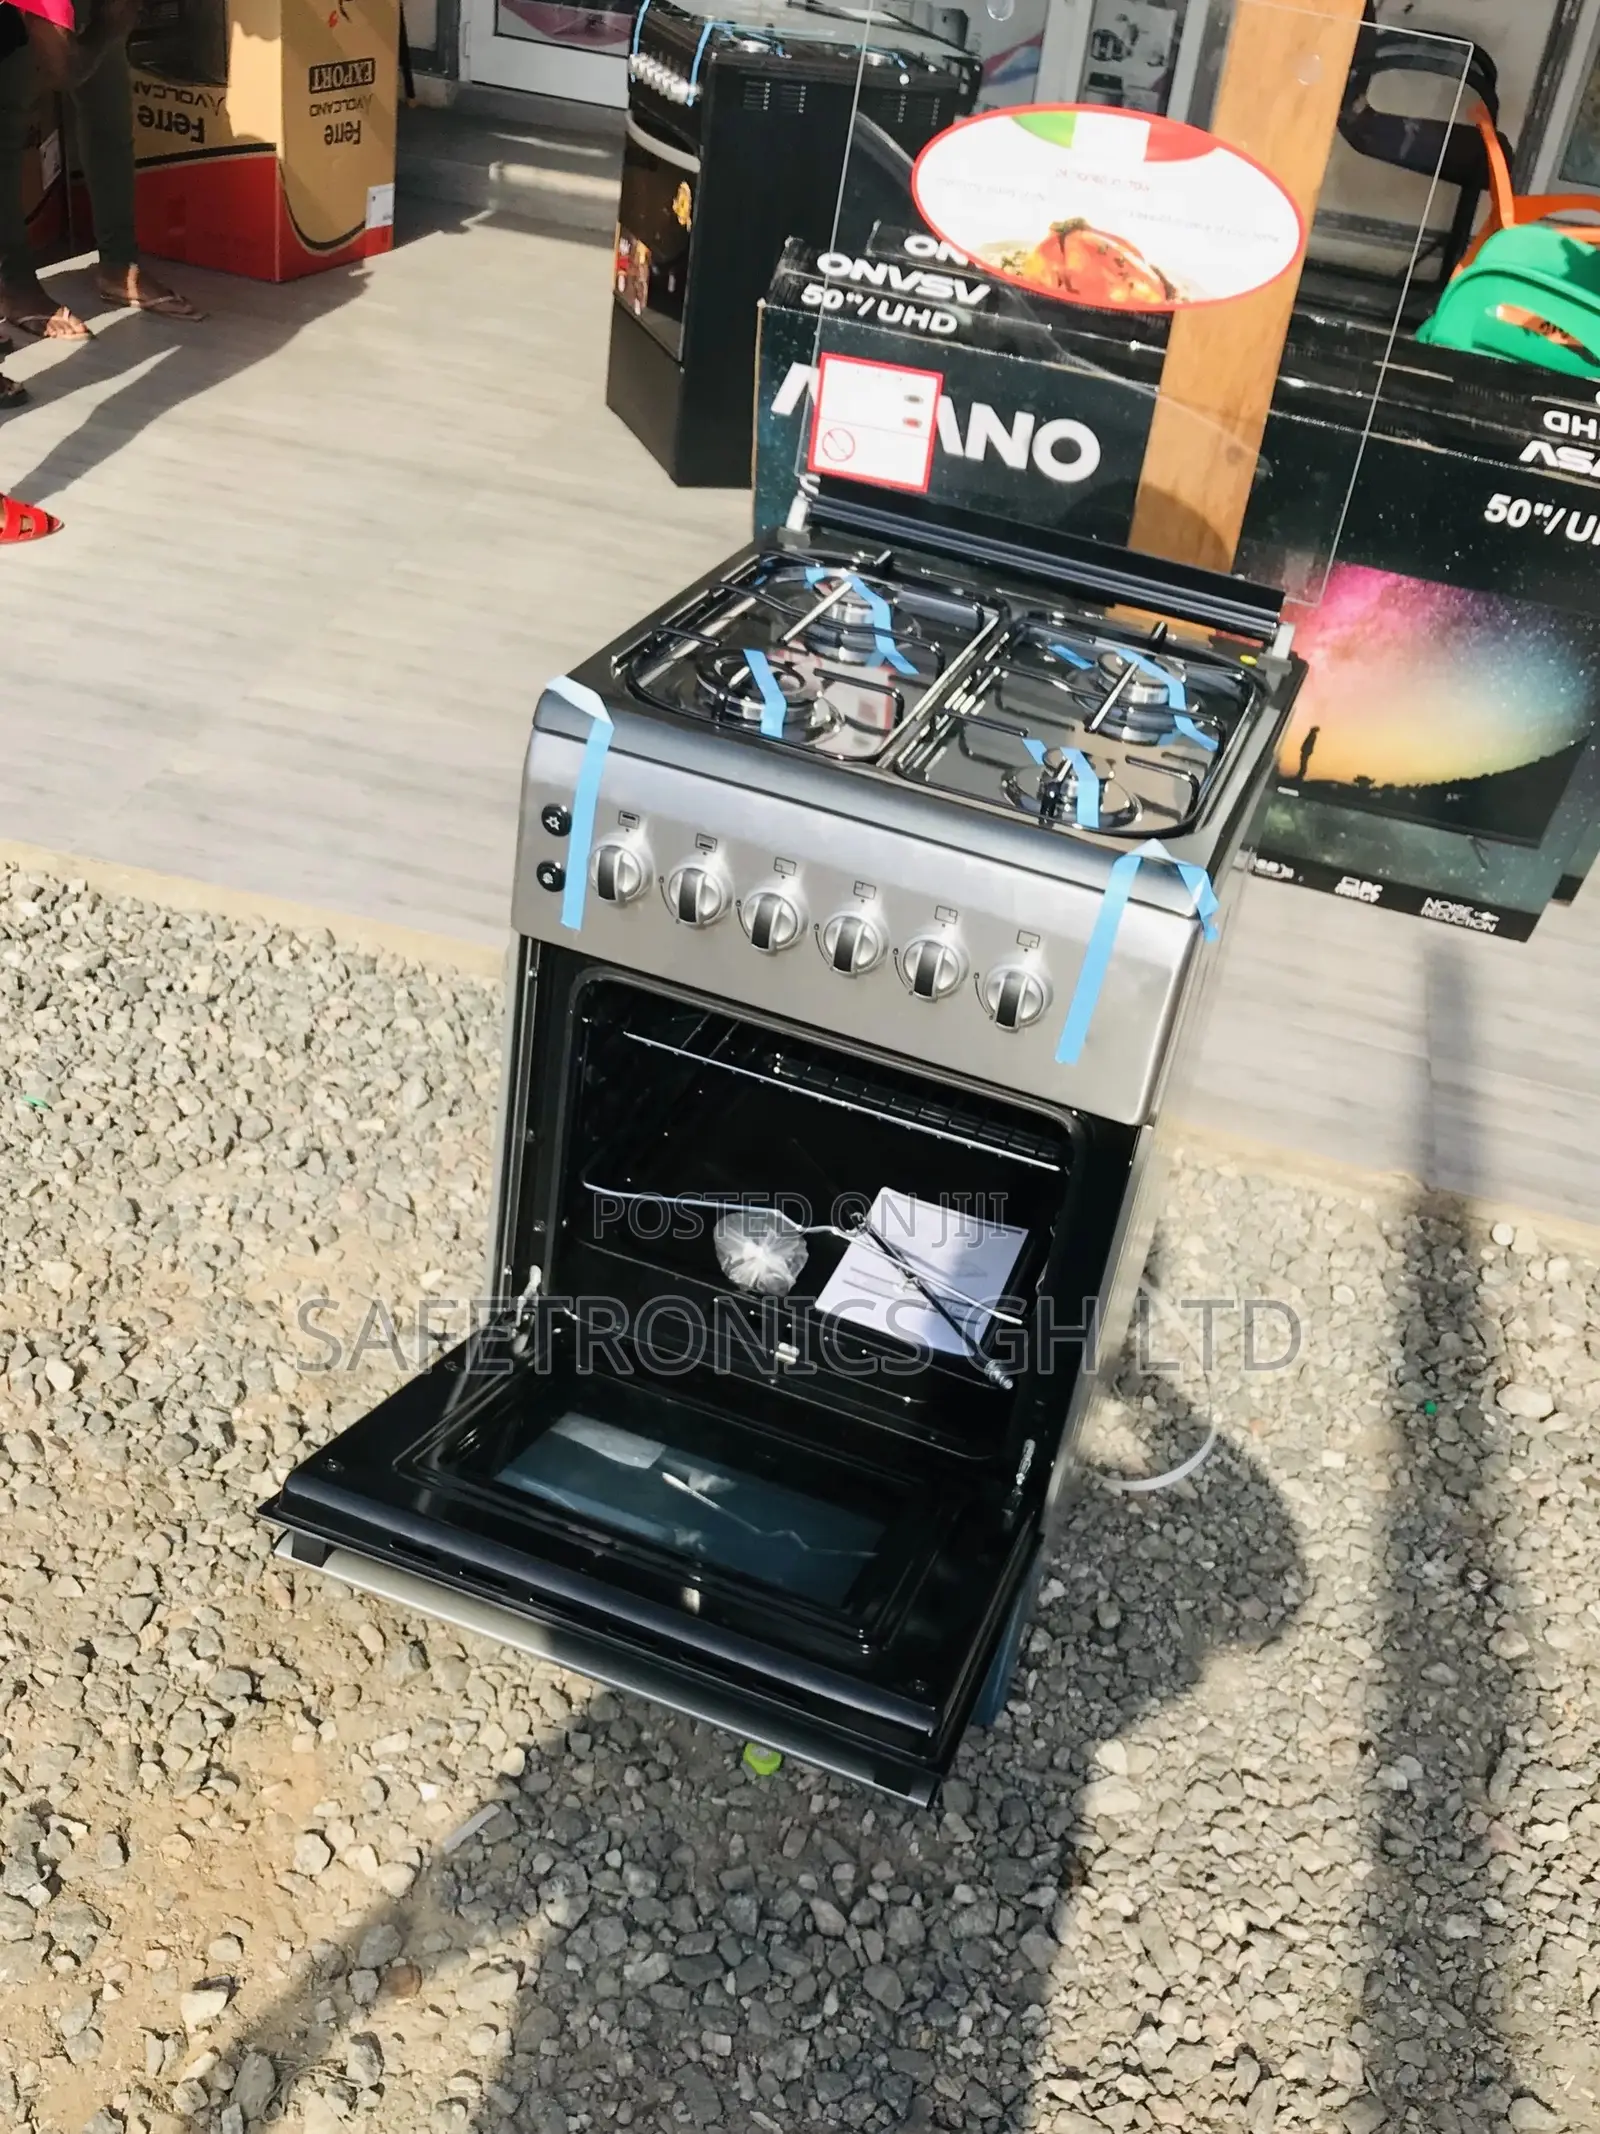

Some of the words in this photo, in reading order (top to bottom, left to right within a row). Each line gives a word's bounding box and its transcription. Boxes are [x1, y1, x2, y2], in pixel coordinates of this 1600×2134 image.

[312, 61, 374, 92] EXPORT
[309, 96, 366, 117] VOLCANO
[137, 105, 205, 143] Ferre
[324, 120, 361, 145] Ferre
[1423, 897, 1474, 917] NOISE
[1421, 907, 1497, 933] REDUCTION
